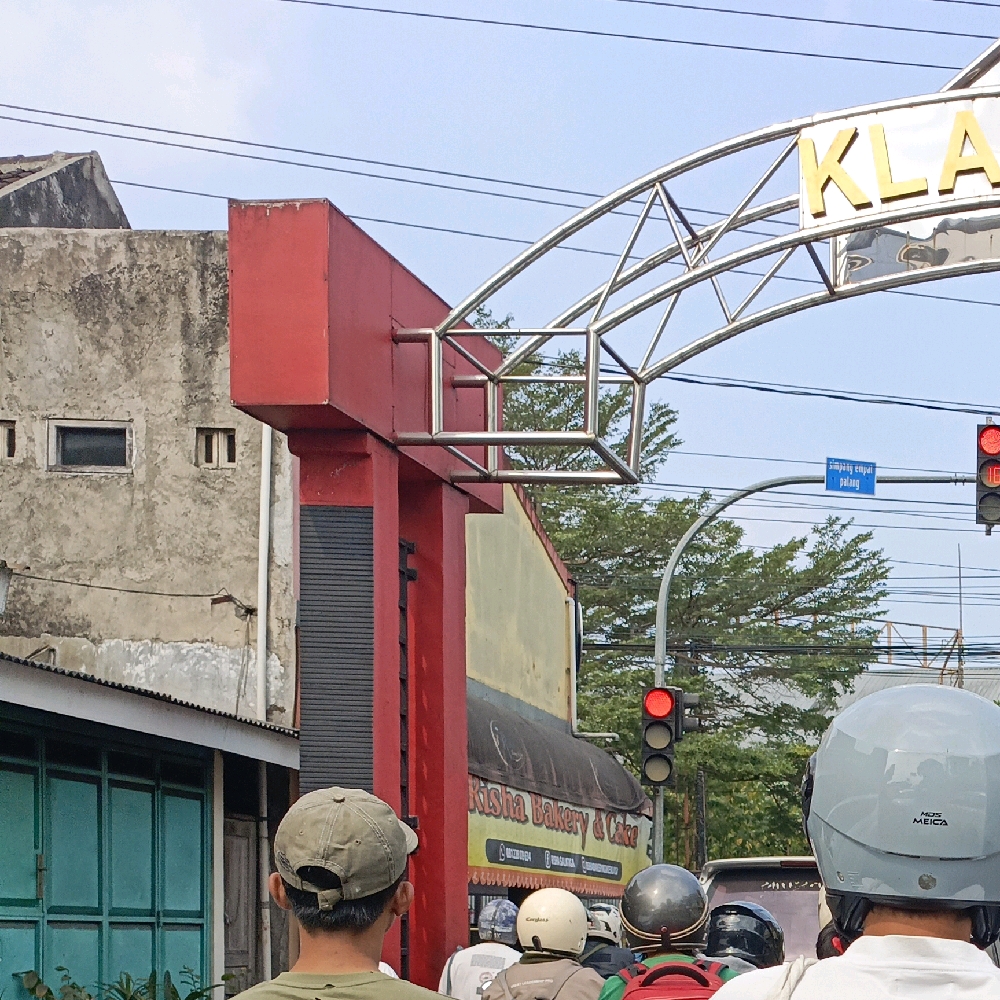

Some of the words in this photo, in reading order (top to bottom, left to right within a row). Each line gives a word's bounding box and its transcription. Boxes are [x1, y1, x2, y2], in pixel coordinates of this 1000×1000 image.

[840, 476, 860, 490] palang
[468, 776, 528, 823] Risha
[529, 793, 590, 851] Bakery
[592, 810, 605, 841] &
[605, 810, 640, 849] Cake
[912, 818, 948, 826] MEICA
